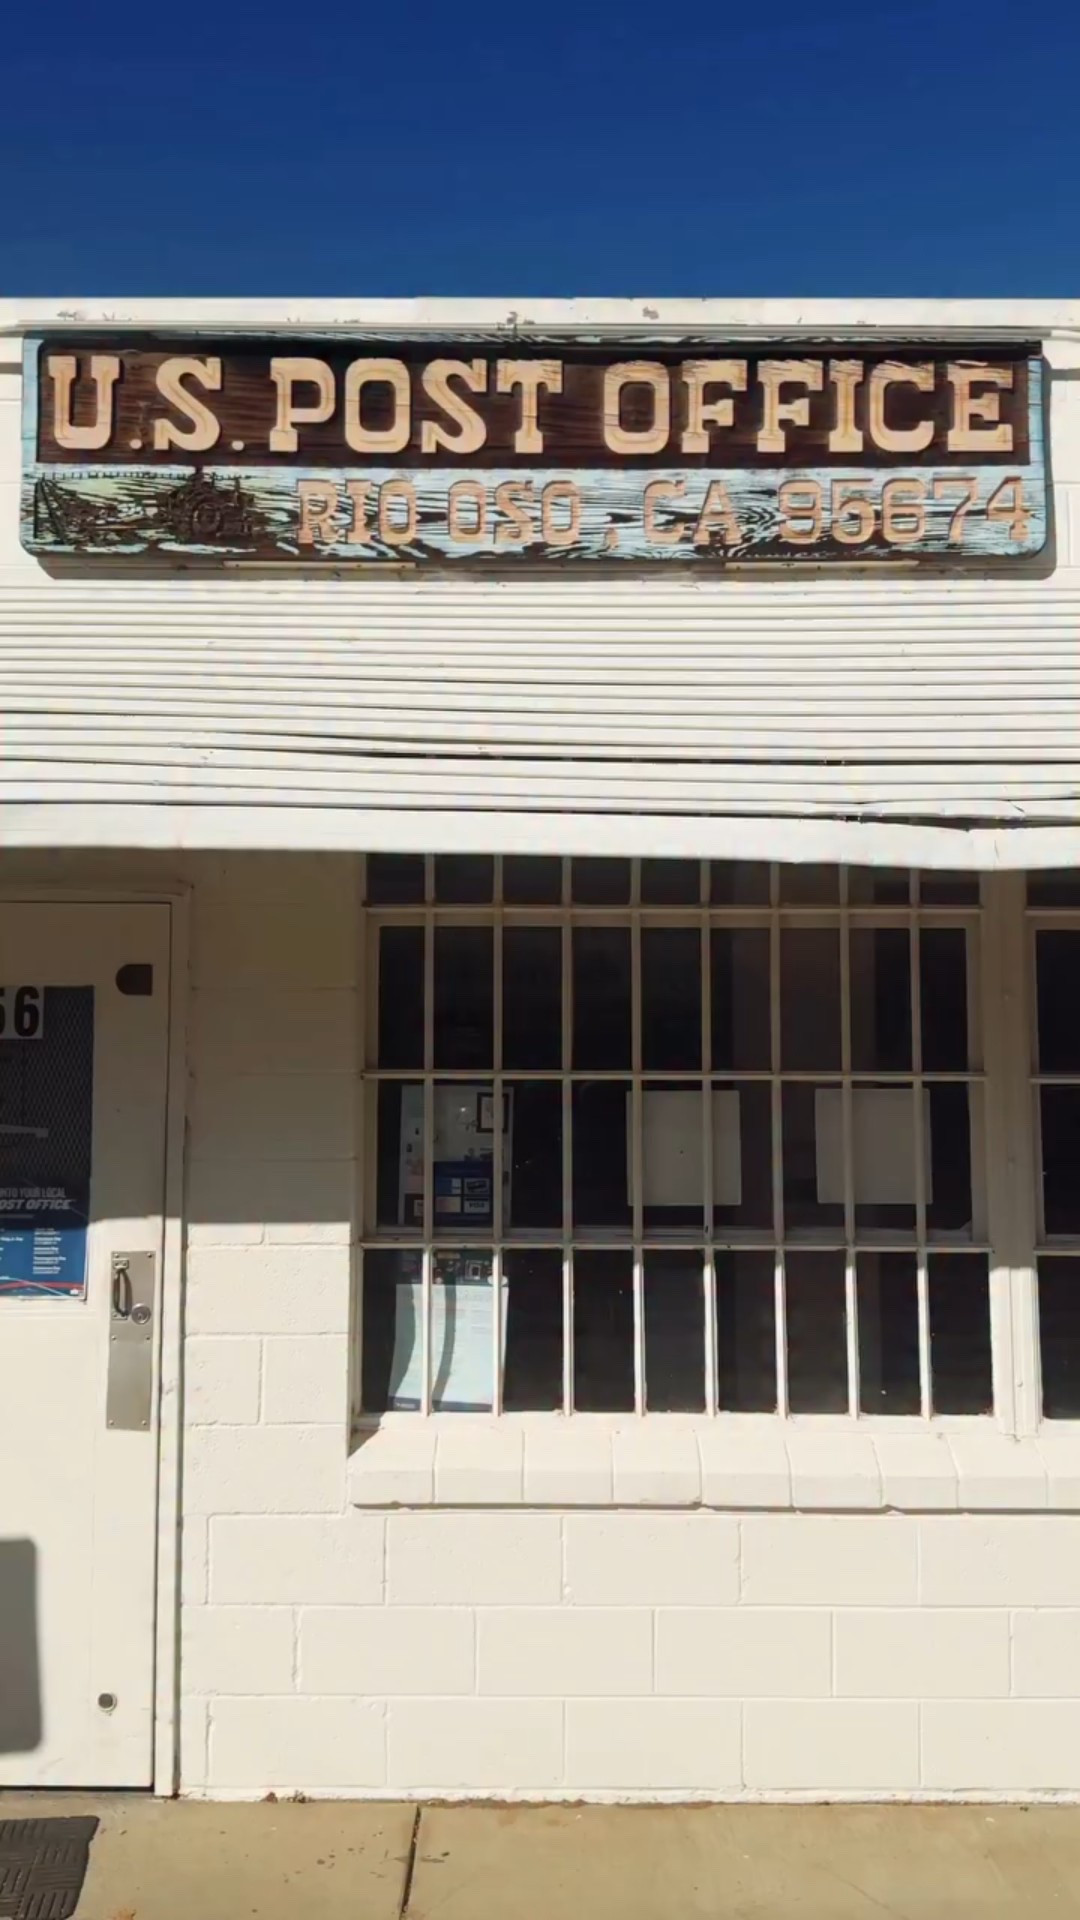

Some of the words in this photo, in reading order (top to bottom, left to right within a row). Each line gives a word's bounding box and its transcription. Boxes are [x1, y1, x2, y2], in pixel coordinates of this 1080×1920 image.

[47, 355, 244, 451] U.S.
[269, 357, 563, 454] POST
[603, 358, 1014, 455] OFFICE
[297, 478, 417, 545] RIO
[643, 478, 744, 546] CA
[777, 476, 1030, 545] 95674
[0, 986, 40, 1037] 6
[25, 1199, 72, 1209] OFFICE
